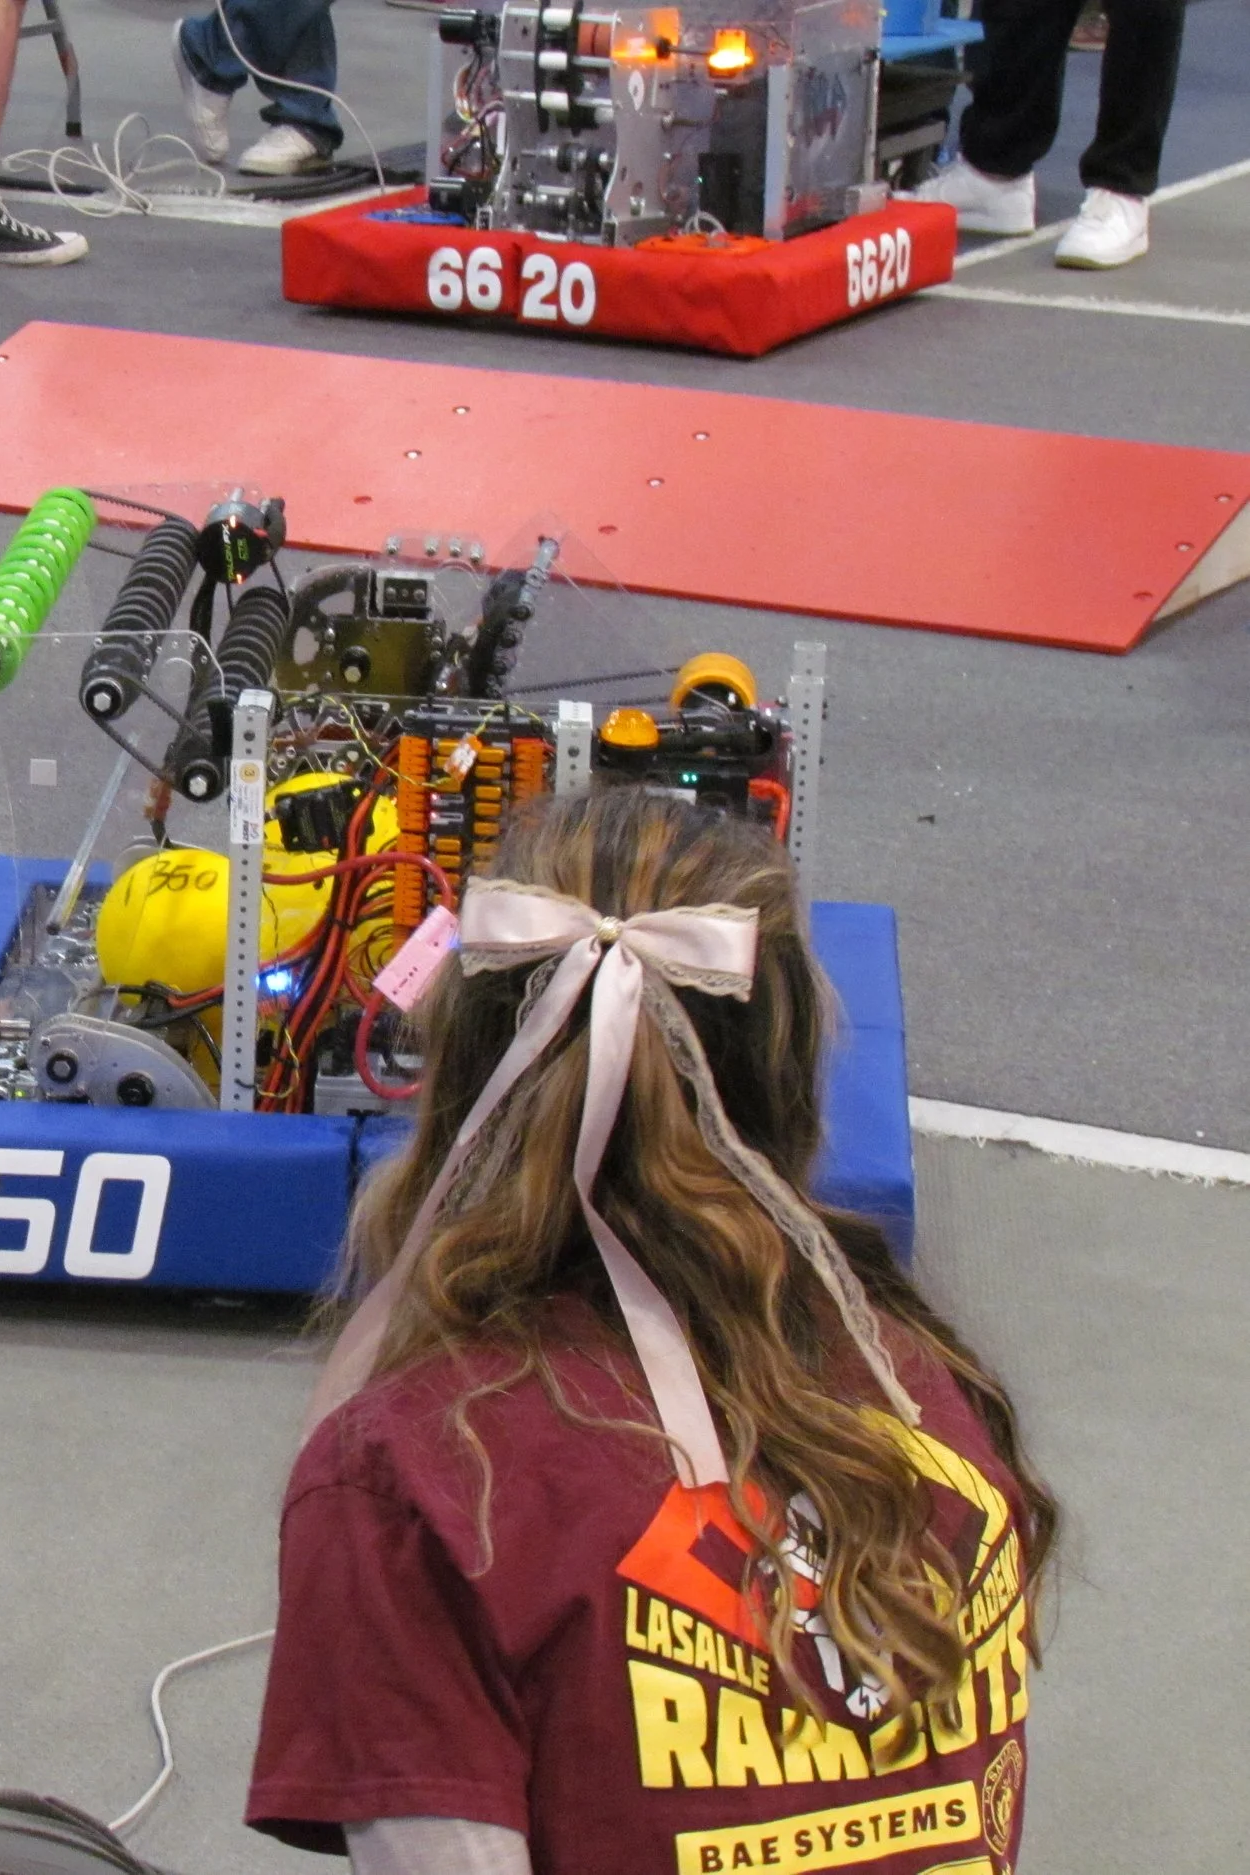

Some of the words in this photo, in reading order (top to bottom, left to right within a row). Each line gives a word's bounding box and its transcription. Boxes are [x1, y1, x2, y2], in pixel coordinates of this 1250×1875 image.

[847, 228, 910, 307] 6620
[124, 860, 219, 907] 1350
[625, 1586, 770, 1696] LASALLE
[700, 1836, 781, 1874] BAE
[794, 1798, 967, 1858] SYSTEMS
